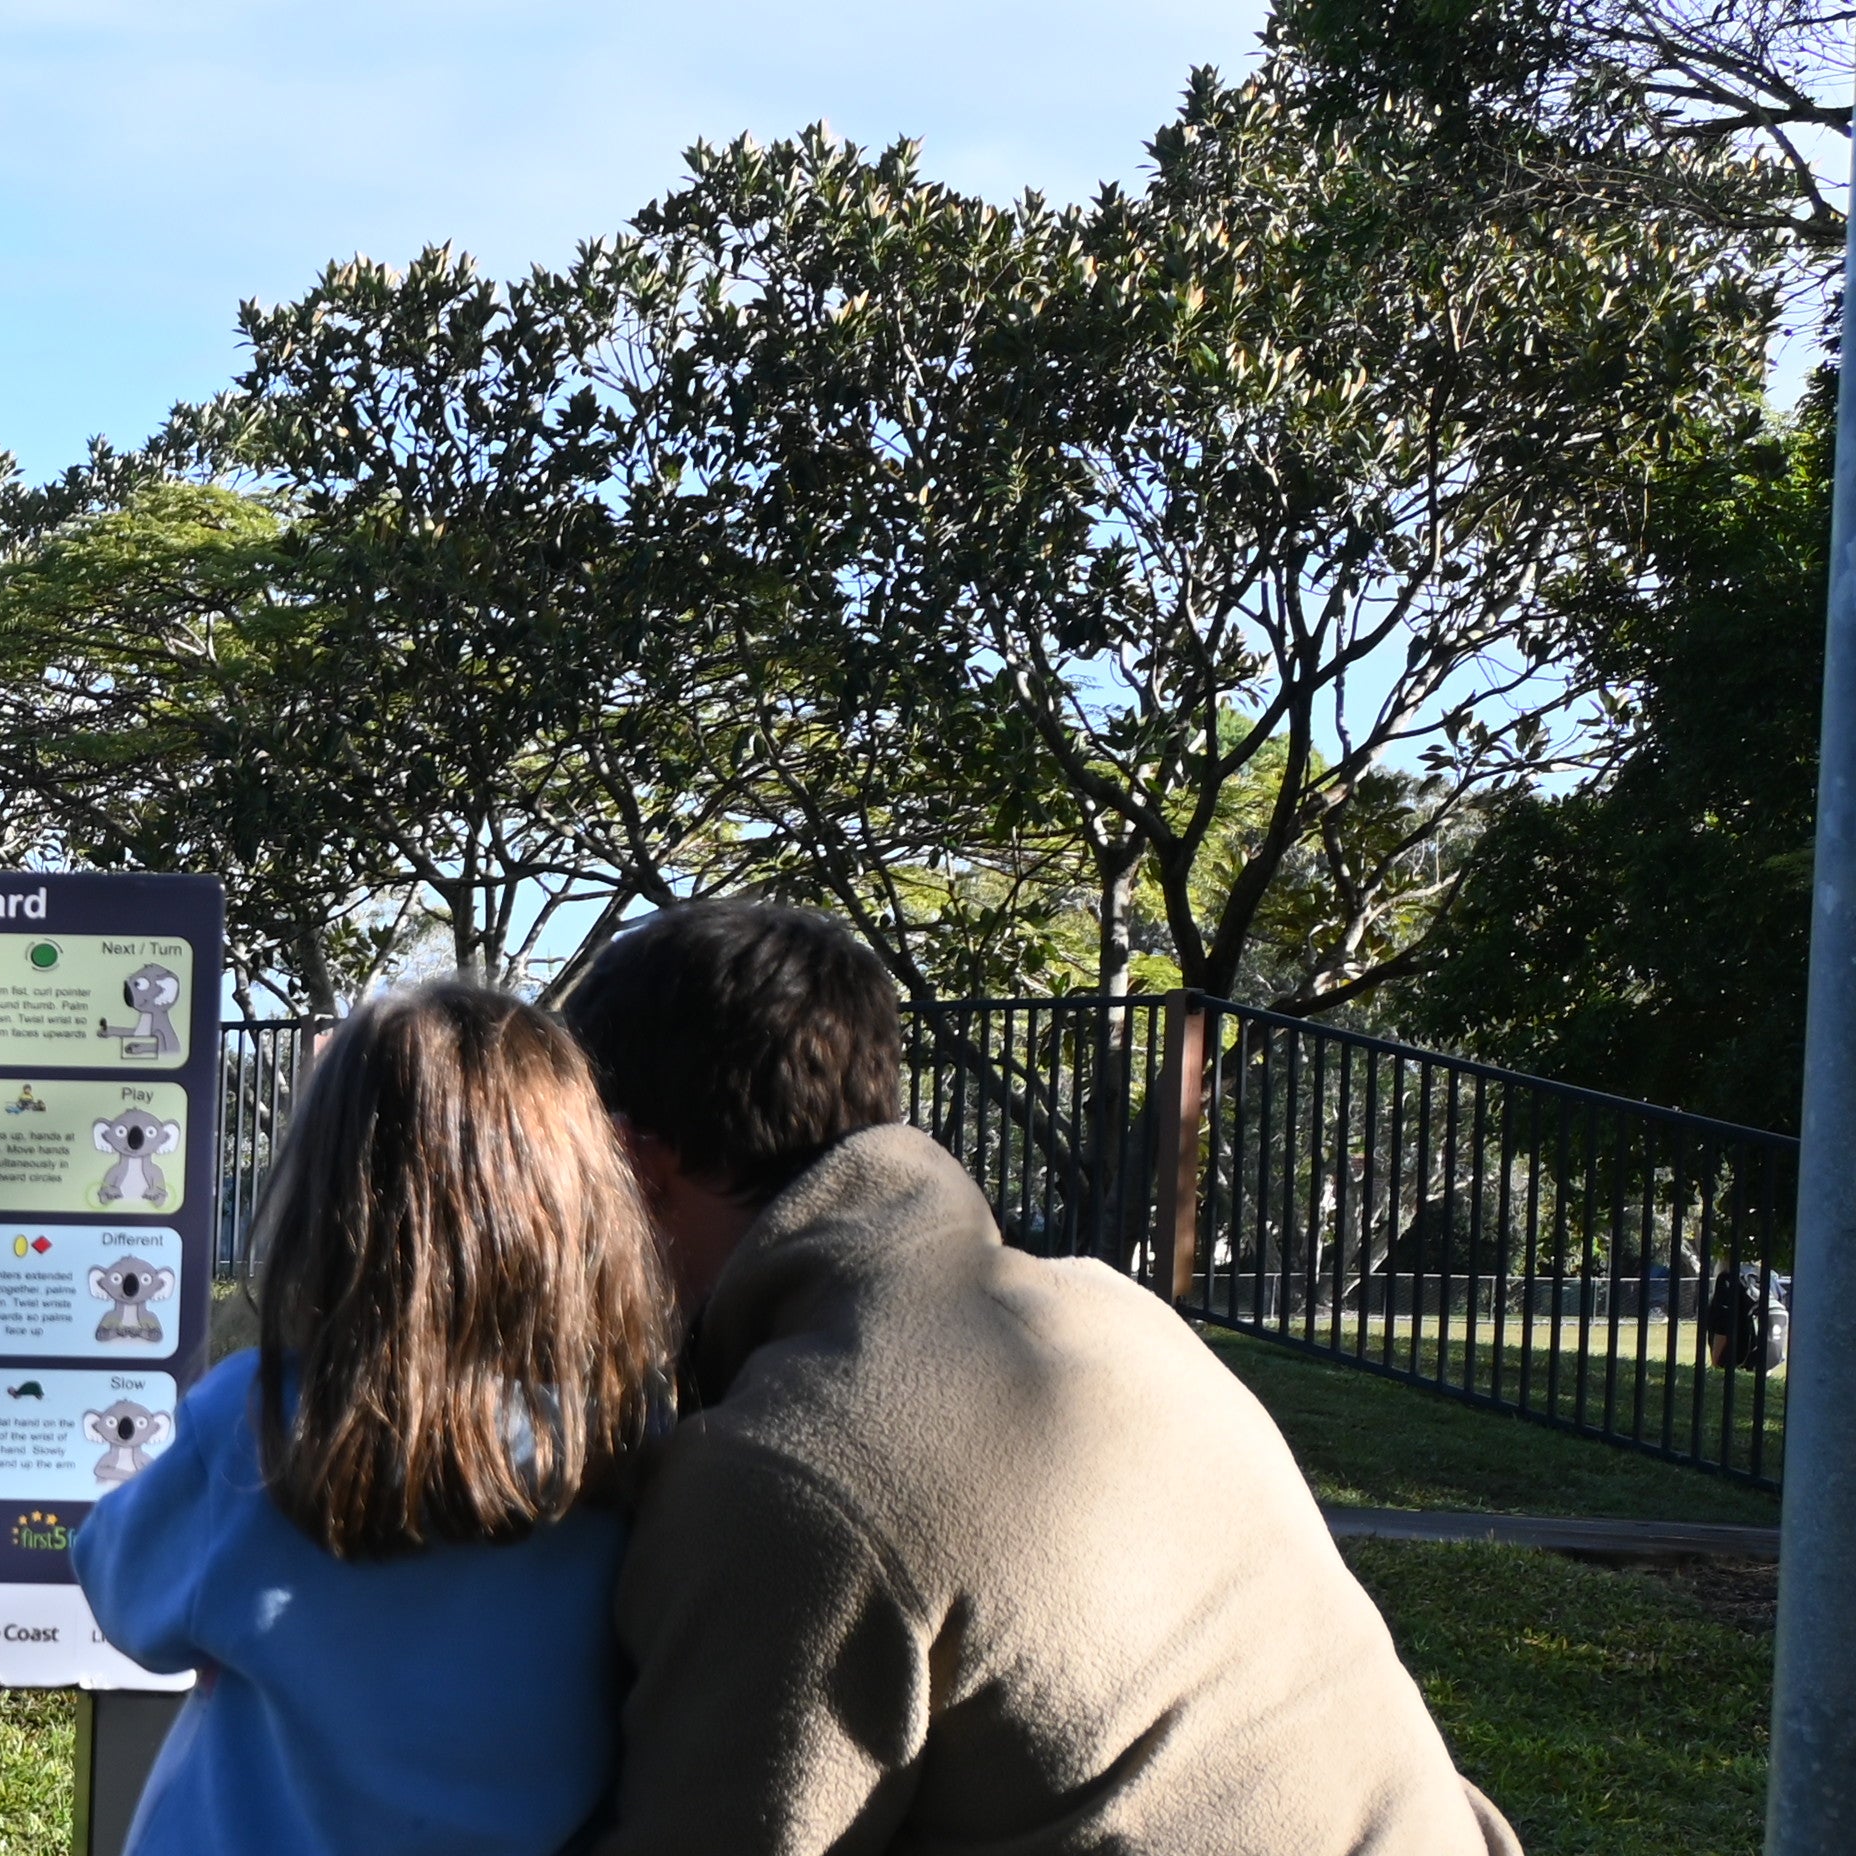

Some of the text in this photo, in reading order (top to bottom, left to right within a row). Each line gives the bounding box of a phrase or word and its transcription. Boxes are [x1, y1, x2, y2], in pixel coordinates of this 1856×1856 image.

[102, 941, 135, 955] Next
[150, 942, 182, 956] Turn
[121, 1087, 154, 1105] Play
[102, 1232, 163, 1247] Different
[110, 1376, 146, 1390] Slow
[3, 1623, 59, 1642] Coast
